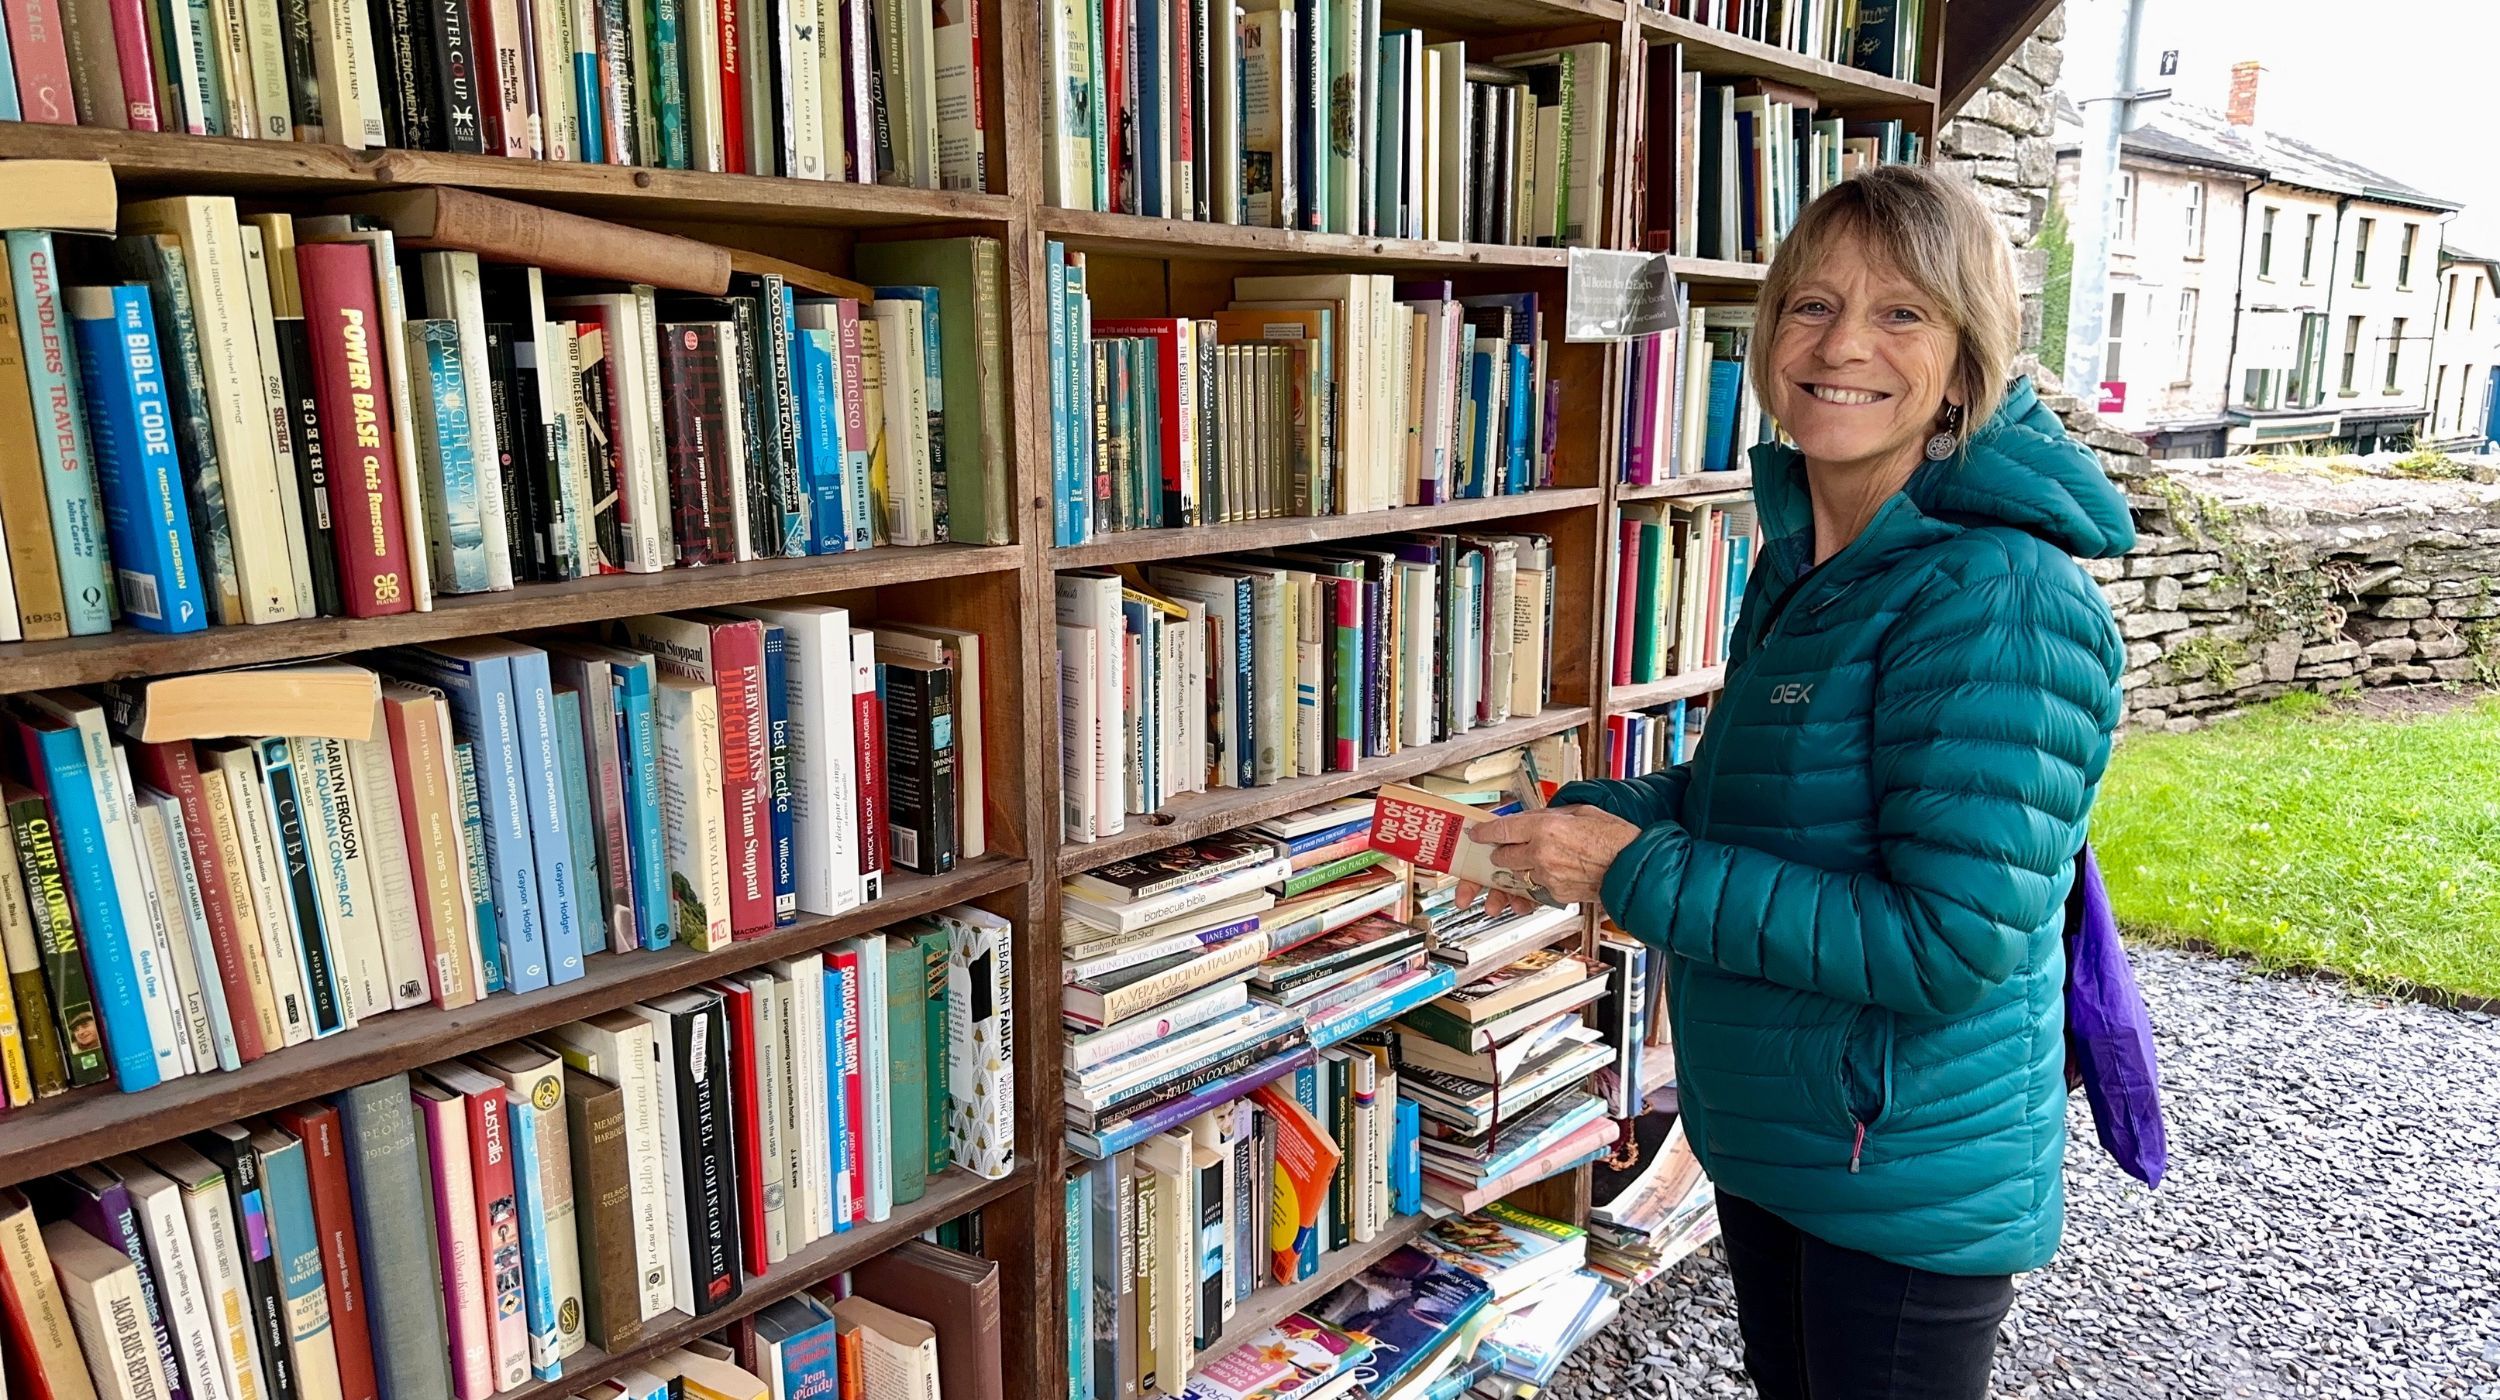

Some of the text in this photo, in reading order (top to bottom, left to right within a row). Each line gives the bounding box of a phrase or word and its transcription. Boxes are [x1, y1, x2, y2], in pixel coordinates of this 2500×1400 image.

[191, 19, 211, 105] THE ROUGH GUIDE
[451, 51, 468, 100] COUP
[723, 23, 736, 74] Cookery
[891, 38, 899, 76] HUNGER
[402, 35, 419, 125] PREDICAMENT
[871, 69, 889, 149] Terry Fulton
[1561, 82, 1572, 118] Small
[454, 126, 475, 138] HAY
[569, 116, 578, 142] Foyles
[1560, 121, 1571, 165] Estates
[1050, 264, 1064, 347] COUNTRYBLAST
[1580, 276, 1591, 288] All
[1591, 277, 1611, 289] Books
[1633, 279, 1653, 290] Each
[1071, 304, 1079, 358] TEACHING
[1179, 345, 1188, 360] THE
[29, 250, 79, 473] CHANDLERS' TRAVELS
[769, 280, 793, 450] FOOD COMBINING FOR HEALTH
[842, 318, 862, 430] San Francisco
[268, 375, 291, 456] EPHESUS 1992
[1072, 369, 1080, 415] NURSING
[124, 300, 188, 590] THE BIBLE CODE MICHAEL DROSNIN
[303, 397, 325, 485] GREECE
[340, 307, 388, 558] POWER BASE Chris Ransome
[432, 371, 455, 487] GWYNETH JONES
[546, 424, 556, 461] Meetings
[1096, 404, 1109, 473] BREAK NECK
[1181, 407, 1190, 442] MISSION
[855, 461, 866, 521] THE ROUGH GUIDE
[24, 611, 63, 625] 1933
[1238, 584, 1249, 675] FARLEY MOWAT
[742, 664, 761, 783] EVERYWOMAN'S
[1769, 682, 1815, 706] OEX
[310, 741, 324, 765] THE
[720, 668, 750, 785] LIFEGUIDE
[496, 691, 523, 841] CORPORATE SOCIAL OPPORTUNITY!
[535, 687, 560, 834] CORPORATE SOCIAL OPPORTUNITY!
[639, 711, 657, 808] Pennar Davies
[771, 720, 791, 814] best practice
[315, 768, 336, 838] AQUARIAN
[337, 797, 359, 860] FERGUSON
[1375, 798, 1404, 845] One of
[1398, 804, 1425, 842] God's
[279, 799, 307, 878] CUBA
[706, 816, 722, 907] TREVALLION
[741, 787, 763, 902] Miriam Stoppard
[778, 836, 790, 885] Willcocks
[17, 823, 58, 955] THE AUTOBIOGRAPHY
[29, 818, 79, 954] CLIFF MORGAN
[1141, 865, 1220, 896] THE HIGH-FIBRE COOKBOOK
[1288, 856, 1370, 893] FOOD FROM GREEN PLACES
[733, 921, 775, 937] MACDONALD
[1143, 893, 1207, 923] barbecue bible
[1204, 925, 1240, 945] JANE SEN
[1082, 927, 1155, 955] Hamlyn Kitchen Shelf
[310, 949, 329, 1011] ANDREW COE
[782, 997, 790, 1018] Linear
[997, 936, 1012, 1062] SEBASTIAN FAULKS
[1108, 994, 1128, 1011] LA
[1128, 981, 1159, 1006] VERA
[1160, 965, 1200, 992] CUCINA
[1279, 975, 1301, 991] Creative
[187, 991, 209, 1055] Len Davies
[783, 1018, 793, 1061] programming
[841, 965, 858, 1076] SOCIOLOGICAL THEORY
[7, 1048, 21, 1090] HUTCHINSON
[764, 1044, 777, 1158] Economic Relations with the USSR
[788, 1106, 796, 1130] horizon
[484, 1098, 503, 1167] australia
[703, 1154, 720, 1221] COMING
[1240, 1143, 1250, 1225] MAKING LOVE
[709, 1221, 722, 1239] OF
[709, 1239, 725, 1276] AGE
[1136, 1189, 1150, 1279] Country Pottery
[266, 1295, 282, 1348] EXOTIC OPTIONS
[800, 1368, 827, 1387] Jean
[1299, 1371, 1333, 1394] CRAFTS
